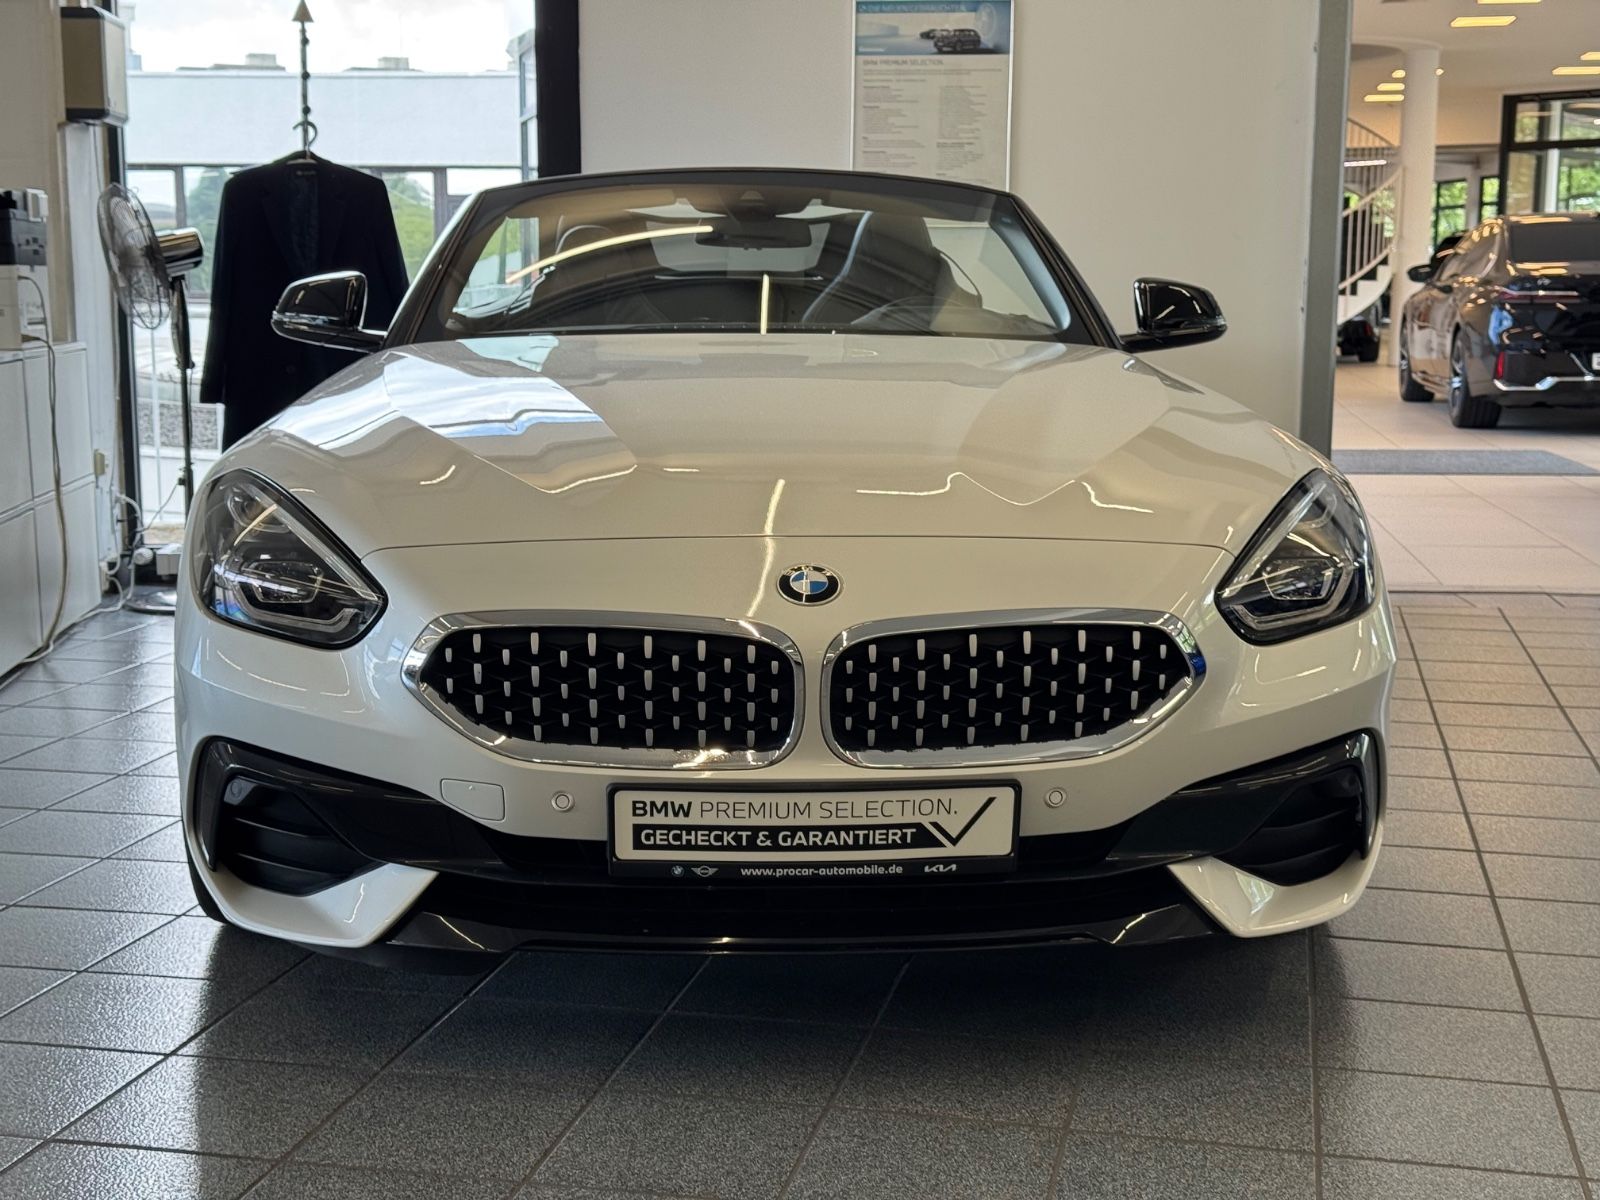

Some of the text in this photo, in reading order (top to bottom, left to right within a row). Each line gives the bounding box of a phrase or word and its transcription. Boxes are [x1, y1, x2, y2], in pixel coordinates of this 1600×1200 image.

[632, 798, 958, 819] BMW PREMIUM SELECTION.
[640, 828, 917, 847] GECHECKT & GARANTIERT
[740, 864, 903, 878] www.procar-automobile.de
